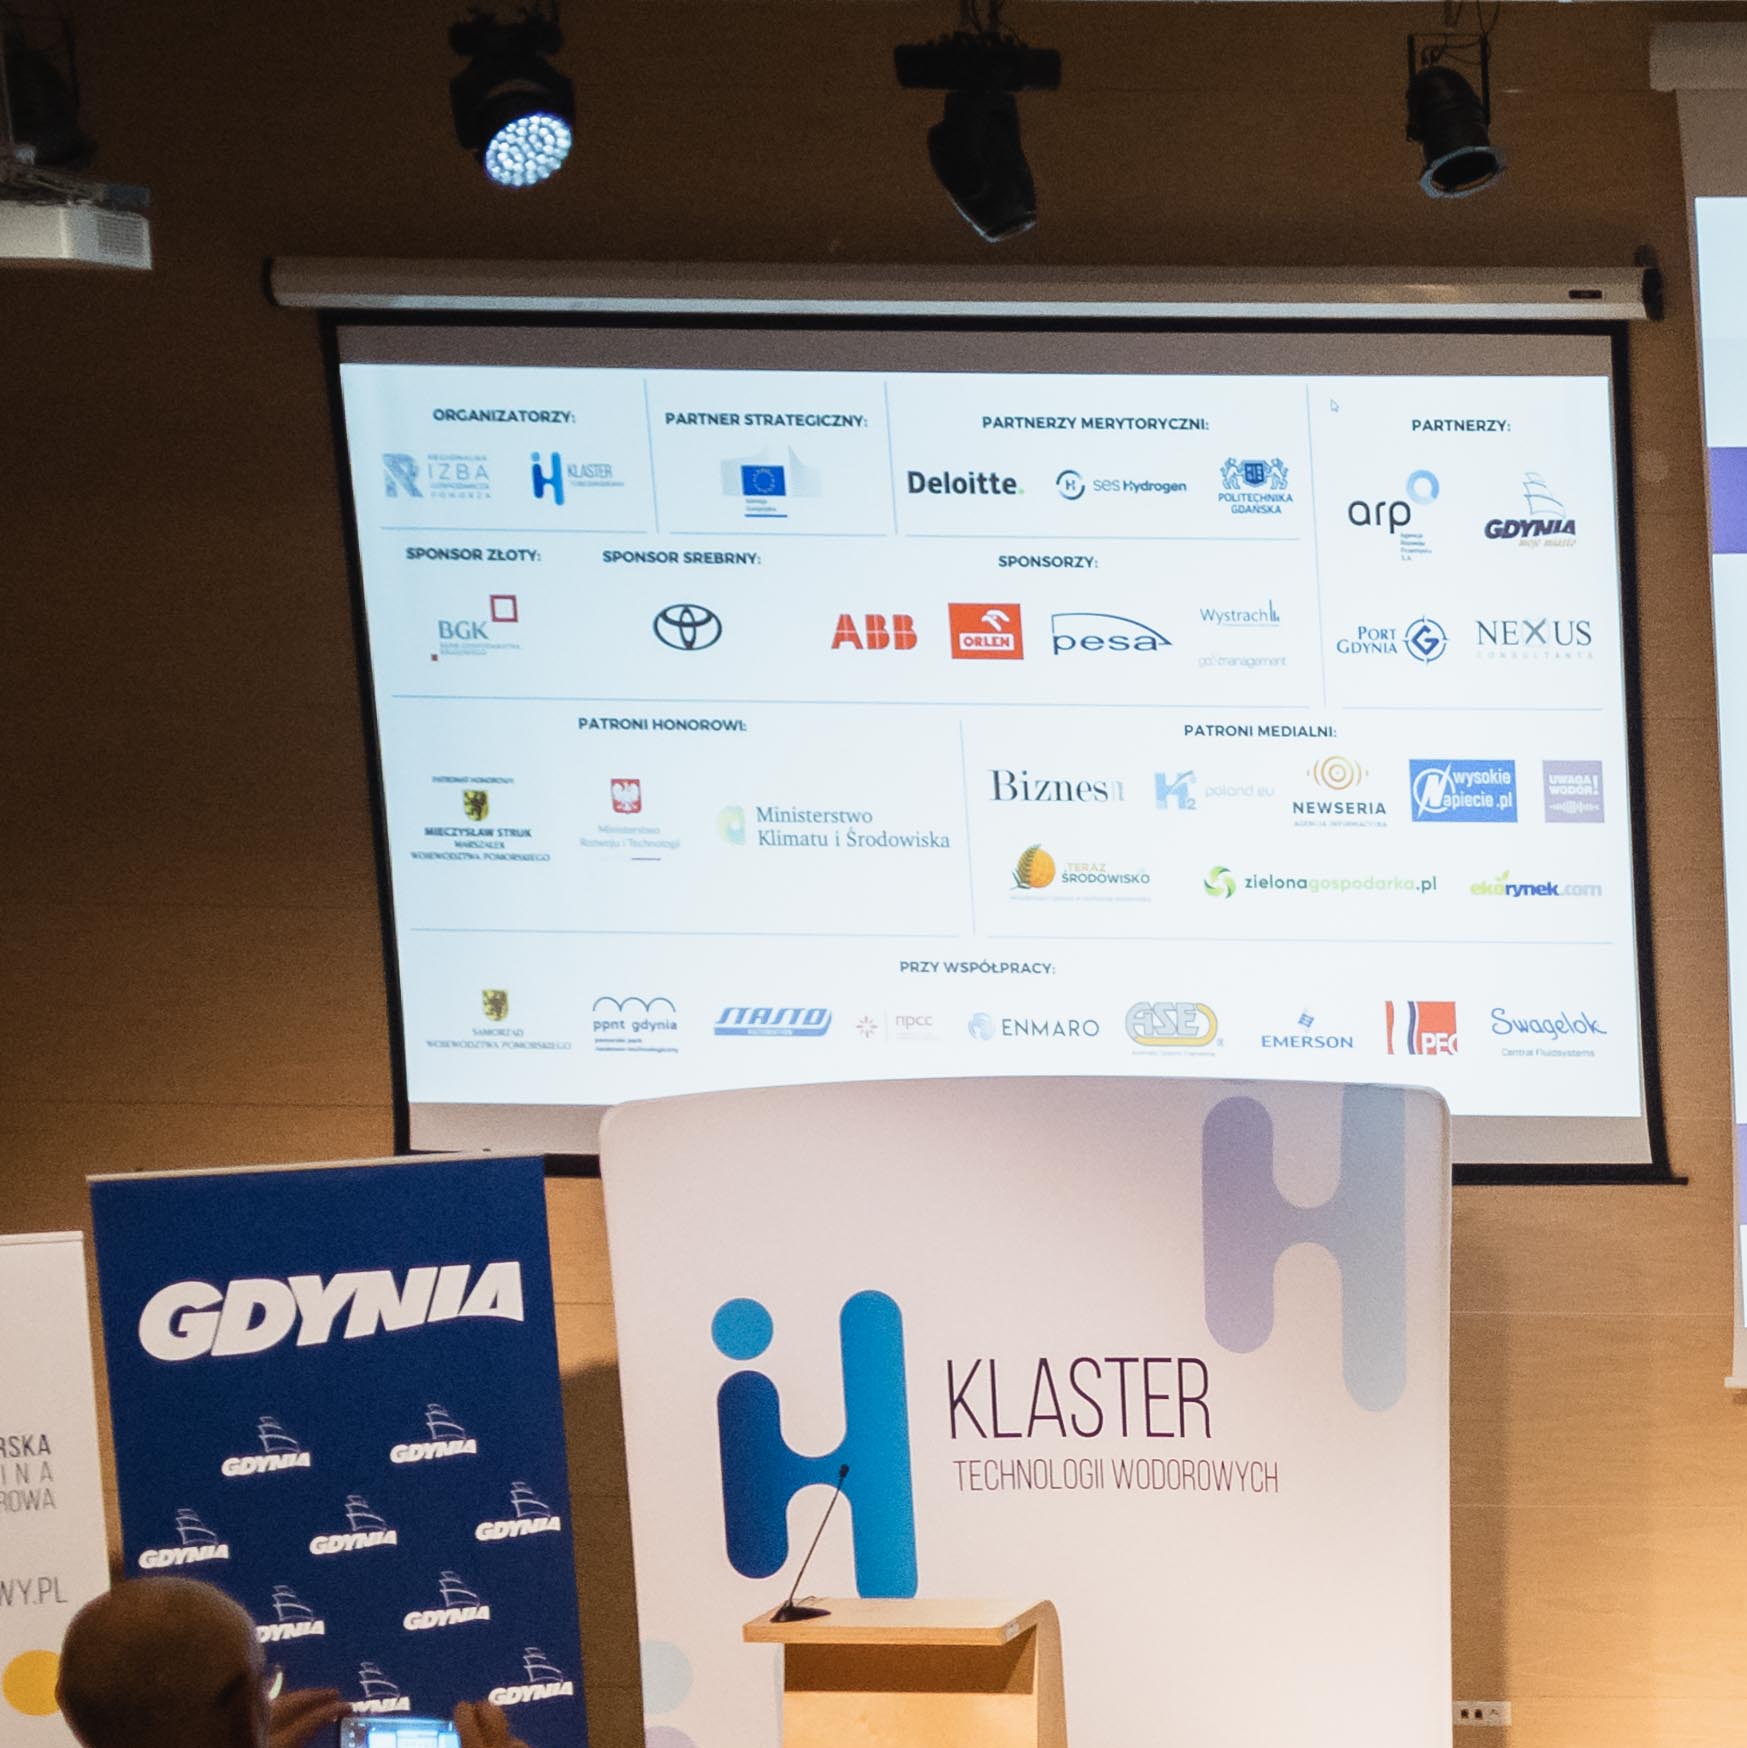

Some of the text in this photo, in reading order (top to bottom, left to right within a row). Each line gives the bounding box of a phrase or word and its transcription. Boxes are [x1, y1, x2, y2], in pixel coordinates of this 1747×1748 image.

[433, 408, 576, 424] ORGANIZATORZY:
[665, 412, 868, 428] PARTNER STRATEGICZNY:
[982, 416, 1210, 432] PARTNERZY MERYTORYCZNI:
[1412, 418, 1511, 433] PARTNERZY:
[1218, 493, 1293, 503] POLITECHNIKA
[1348, 501, 1410, 533] arp
[1485, 519, 1576, 539] GDYNIA
[406, 548, 541, 563] SPONSOR ZŁOTY:
[602, 550, 761, 566] SPONSOR SREBRNY:
[998, 555, 1098, 570] SPONSORZY:
[438, 620, 488, 640] BGK
[831, 614, 918, 650] ABB
[1476, 618, 1592, 646] NEXUS
[963, 636, 1011, 648] ORLEN
[578, 718, 746, 731] PATRONI HONOROWI:
[1184, 724, 1337, 738] PATRONI MEDIALNI:
[989, 769, 1108, 802] Biznes
[1453, 769, 1510, 787] wysokie
[756, 806, 872, 824] Ministerstwo
[1293, 803, 1386, 814] NEWSERIA
[757, 825, 950, 848] Klimatu Środowiska
[1245, 874, 1436, 894] zielonagospodarka.pl
[900, 959, 1058, 975] PRZY WSPÓŁPRACY:
[1002, 1018, 1100, 1038] ENMARO
[1490, 1007, 1607, 1041] Swagelok
[1261, 1036, 1353, 1049] EMERSON
[138, 1261, 524, 1361] GDYNIA
[947, 1356, 1213, 1440] KLASTER
[390, 1439, 476, 1463] GDYNIA
[221, 1452, 310, 1476] GDYNIA
[953, 1459, 1279, 1494] TECHNOLOGII WODOROWYCH
[475, 1516, 561, 1540] GDYNIA
[309, 1530, 397, 1555] GDYNIA
[139, 1544, 228, 1568] GDYNIA
[403, 1606, 490, 1630] GDYNIA
[256, 1620, 325, 1642] DYNIA
[488, 1681, 573, 1705] GDYNIA
